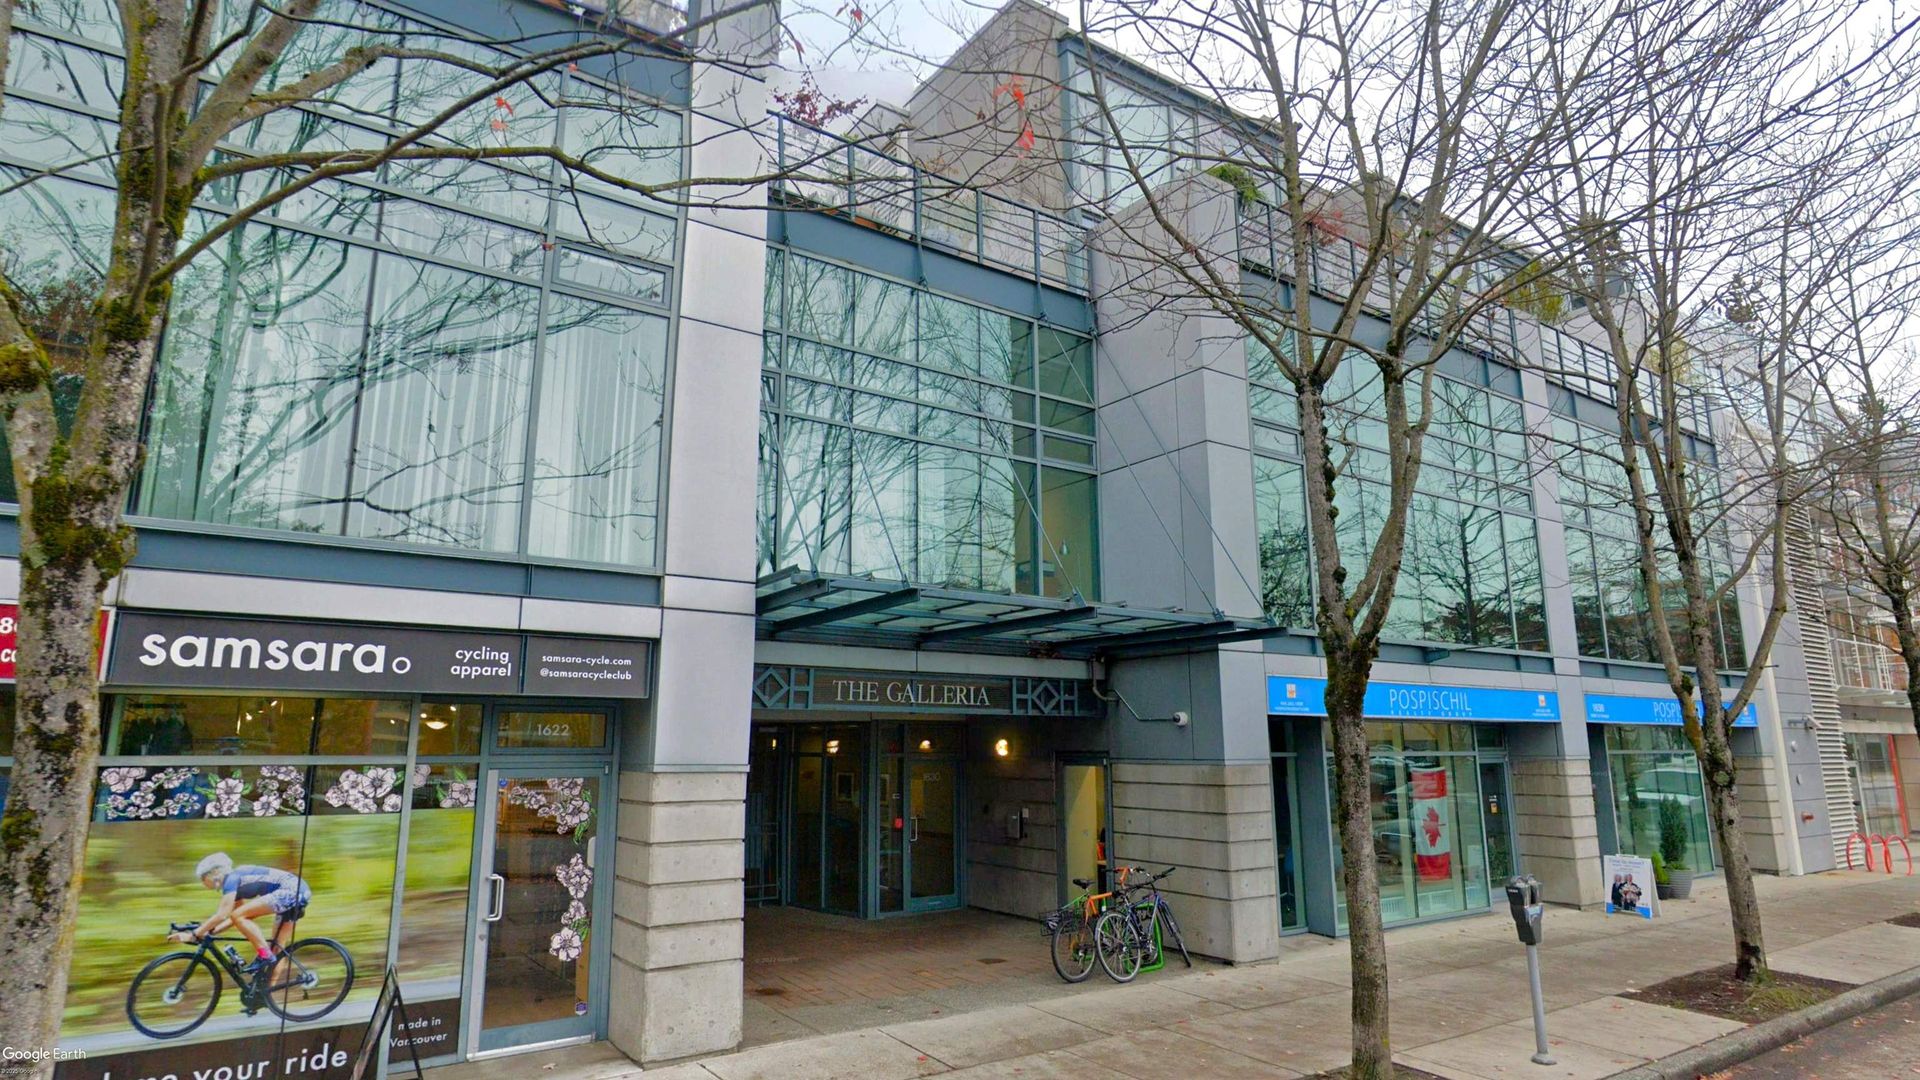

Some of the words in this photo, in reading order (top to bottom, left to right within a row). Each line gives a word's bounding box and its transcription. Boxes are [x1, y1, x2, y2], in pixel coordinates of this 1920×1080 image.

[139, 633, 386, 674] samsara
[455, 646, 509, 664] cycling
[542, 654, 632, 666] samsara-cycle.com
[450, 663, 511, 679] apparel
[540, 668, 632, 681] @samsaracycleclub
[833, 680, 879, 702] THE
[886, 682, 990, 706] GALLERIA
[1389, 688, 1473, 712] POSPISCHIL
[536, 724, 569, 736] 1622
[431, 1016, 441, 1026] in
[284, 1043, 347, 1075] ride
